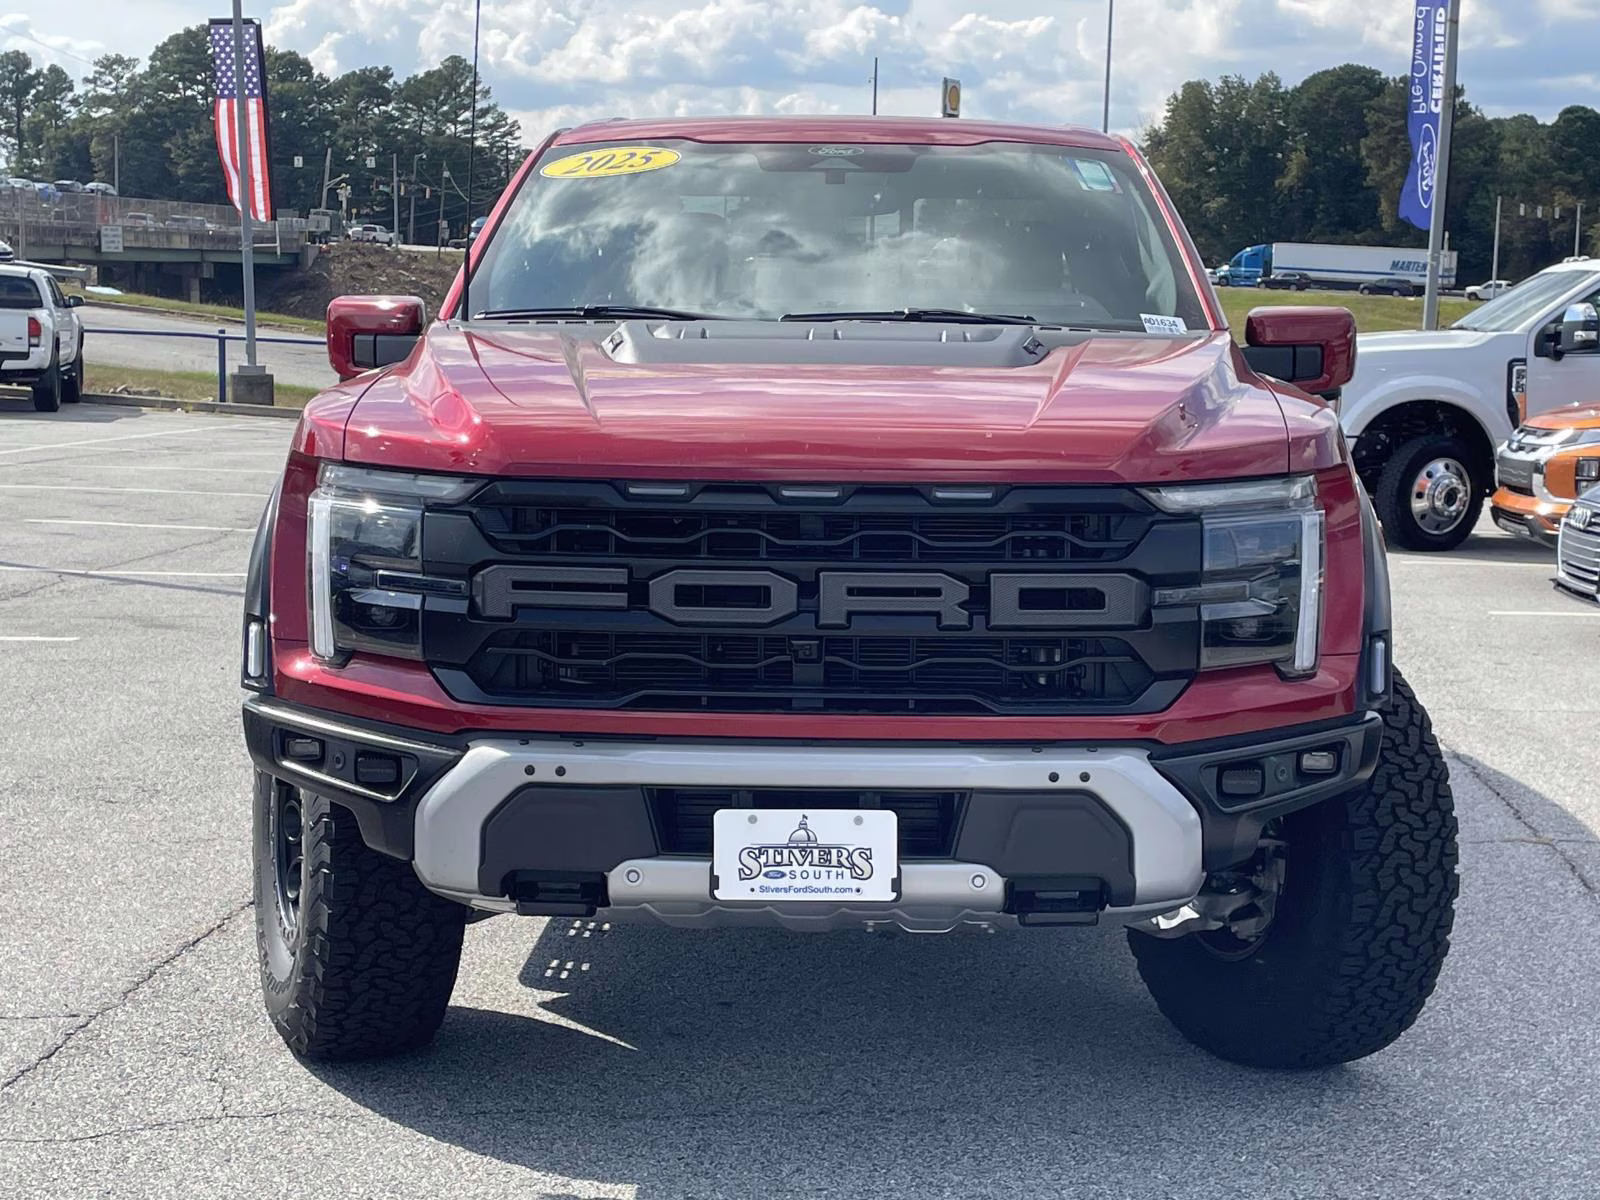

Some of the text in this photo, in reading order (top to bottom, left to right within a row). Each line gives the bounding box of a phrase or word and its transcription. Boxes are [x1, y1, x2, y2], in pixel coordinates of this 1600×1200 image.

[562, 152, 661, 175] 2025
[472, 564, 1146, 630] FORD
[738, 846, 874, 881] STIVERS
[789, 870, 844, 880] SOUTH
[759, 885, 853, 894] StiversFordSouth.com
